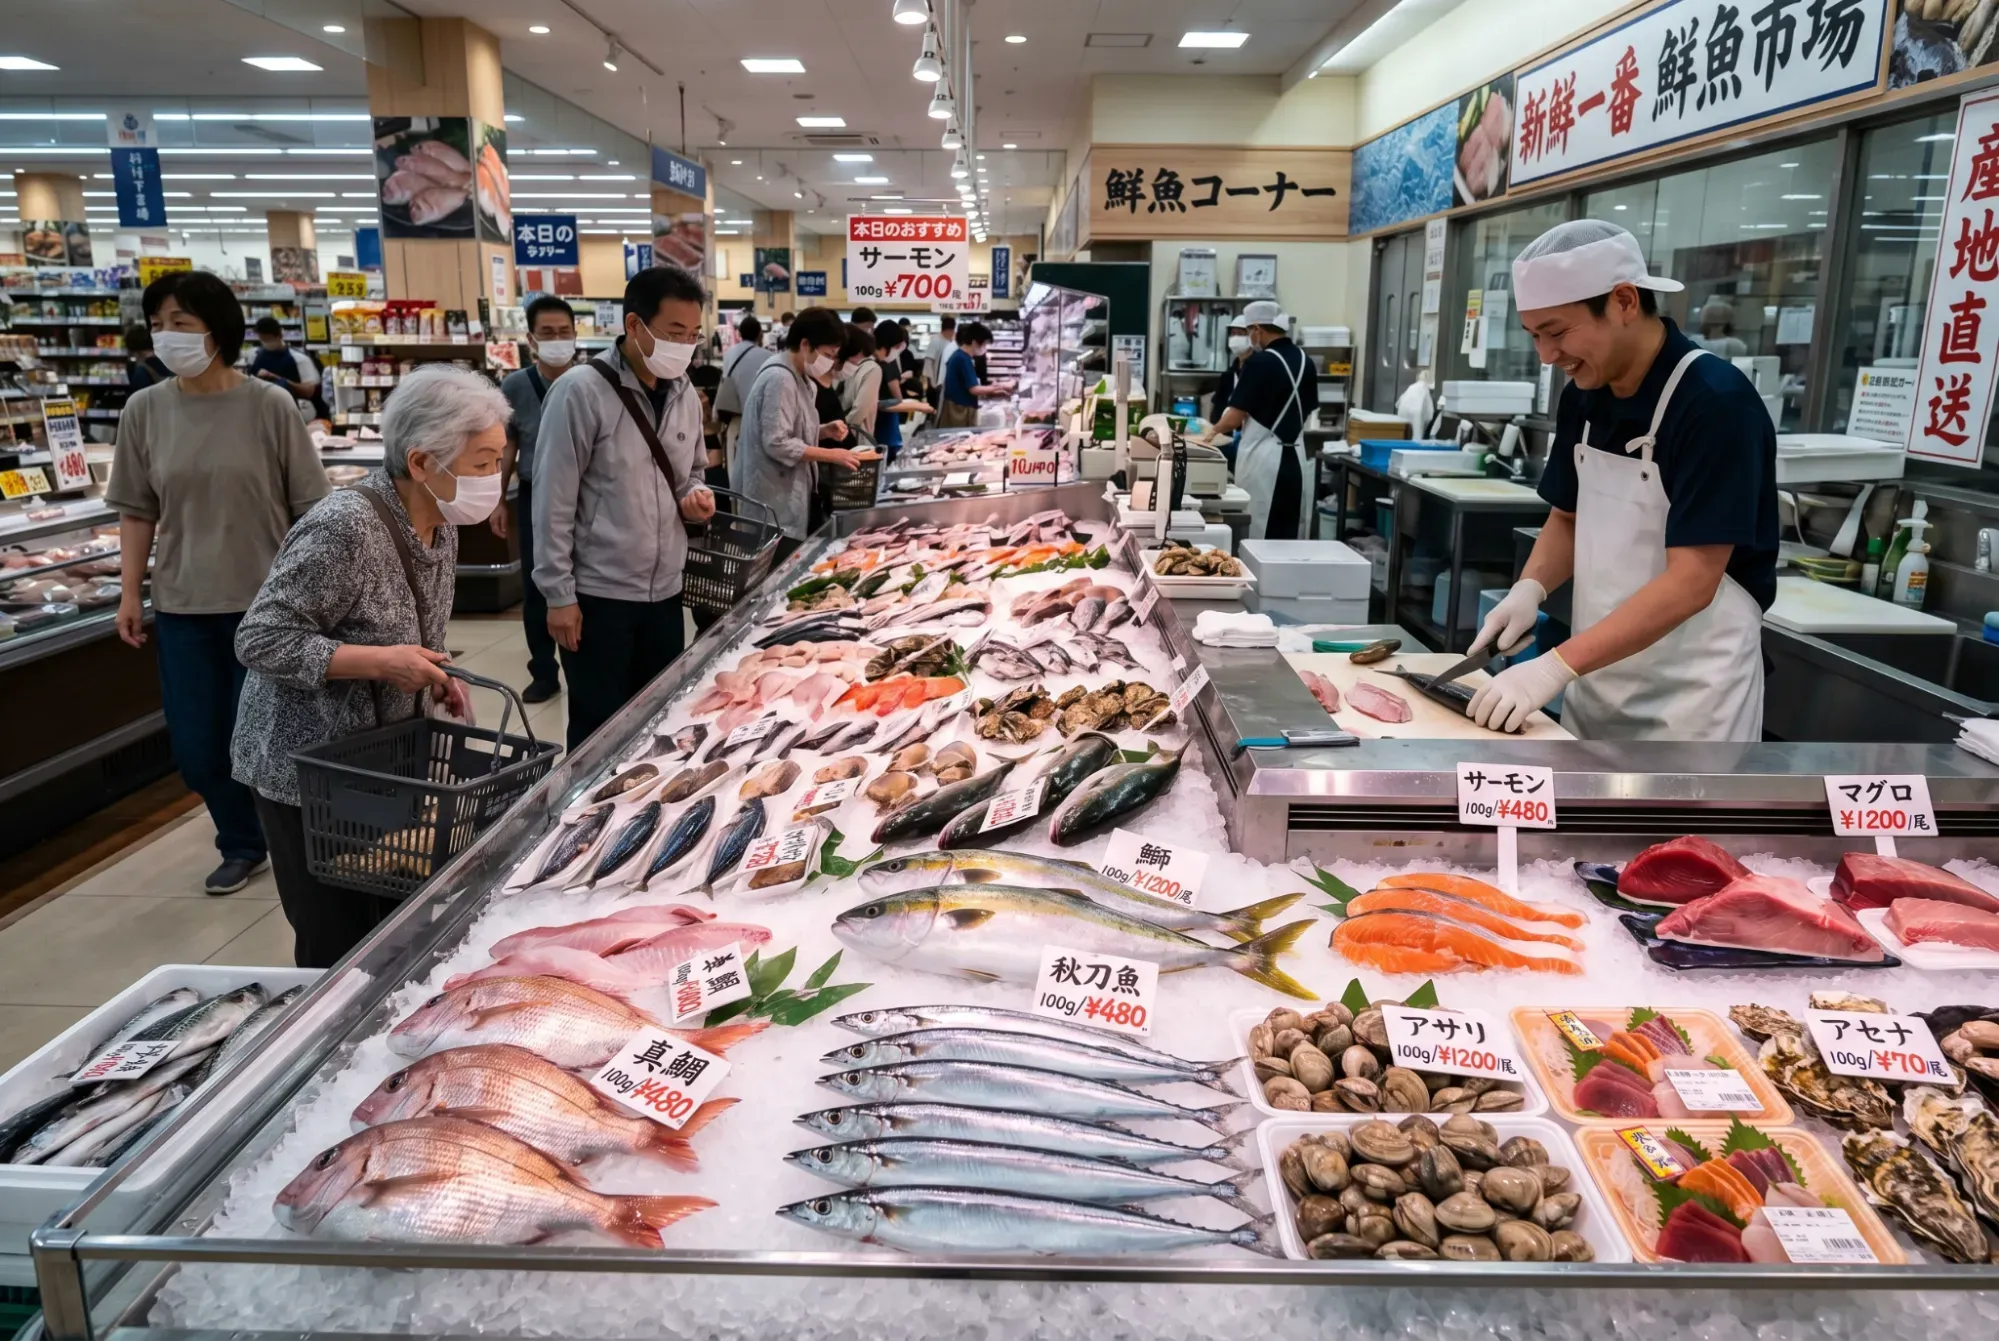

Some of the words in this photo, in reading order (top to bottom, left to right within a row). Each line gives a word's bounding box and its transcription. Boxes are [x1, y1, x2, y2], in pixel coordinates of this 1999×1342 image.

[1519, 45, 1643, 166] 新鮮一番
[1103, 167, 1337, 215] 鮮魚コーナー
[516, 222, 574, 244] 本日の
[853, 221, 962, 238] 本日のおすすめ
[859, 246, 956, 269] サーモン
[854, 285, 883, 298] 100g
[1923, 122, 1999, 447] 産地直送
[1463, 770, 1545, 794] サーモン
[1838, 780, 1913, 804] マグロ
[1465, 799, 1549, 822] 100g/¥480
[1840, 810, 1931, 831] ¥1200/尾
[1135, 842, 1172, 871] 鰤
[1049, 956, 1141, 997] 秋刀魚
[1040, 992, 1147, 1028] 100g/¥480
[1400, 1015, 1486, 1044] アサリ
[1820, 1019, 1913, 1046] アセナ
[633, 1039, 711, 1087] 真鯛
[600, 1067, 694, 1119] 100g/¥480
